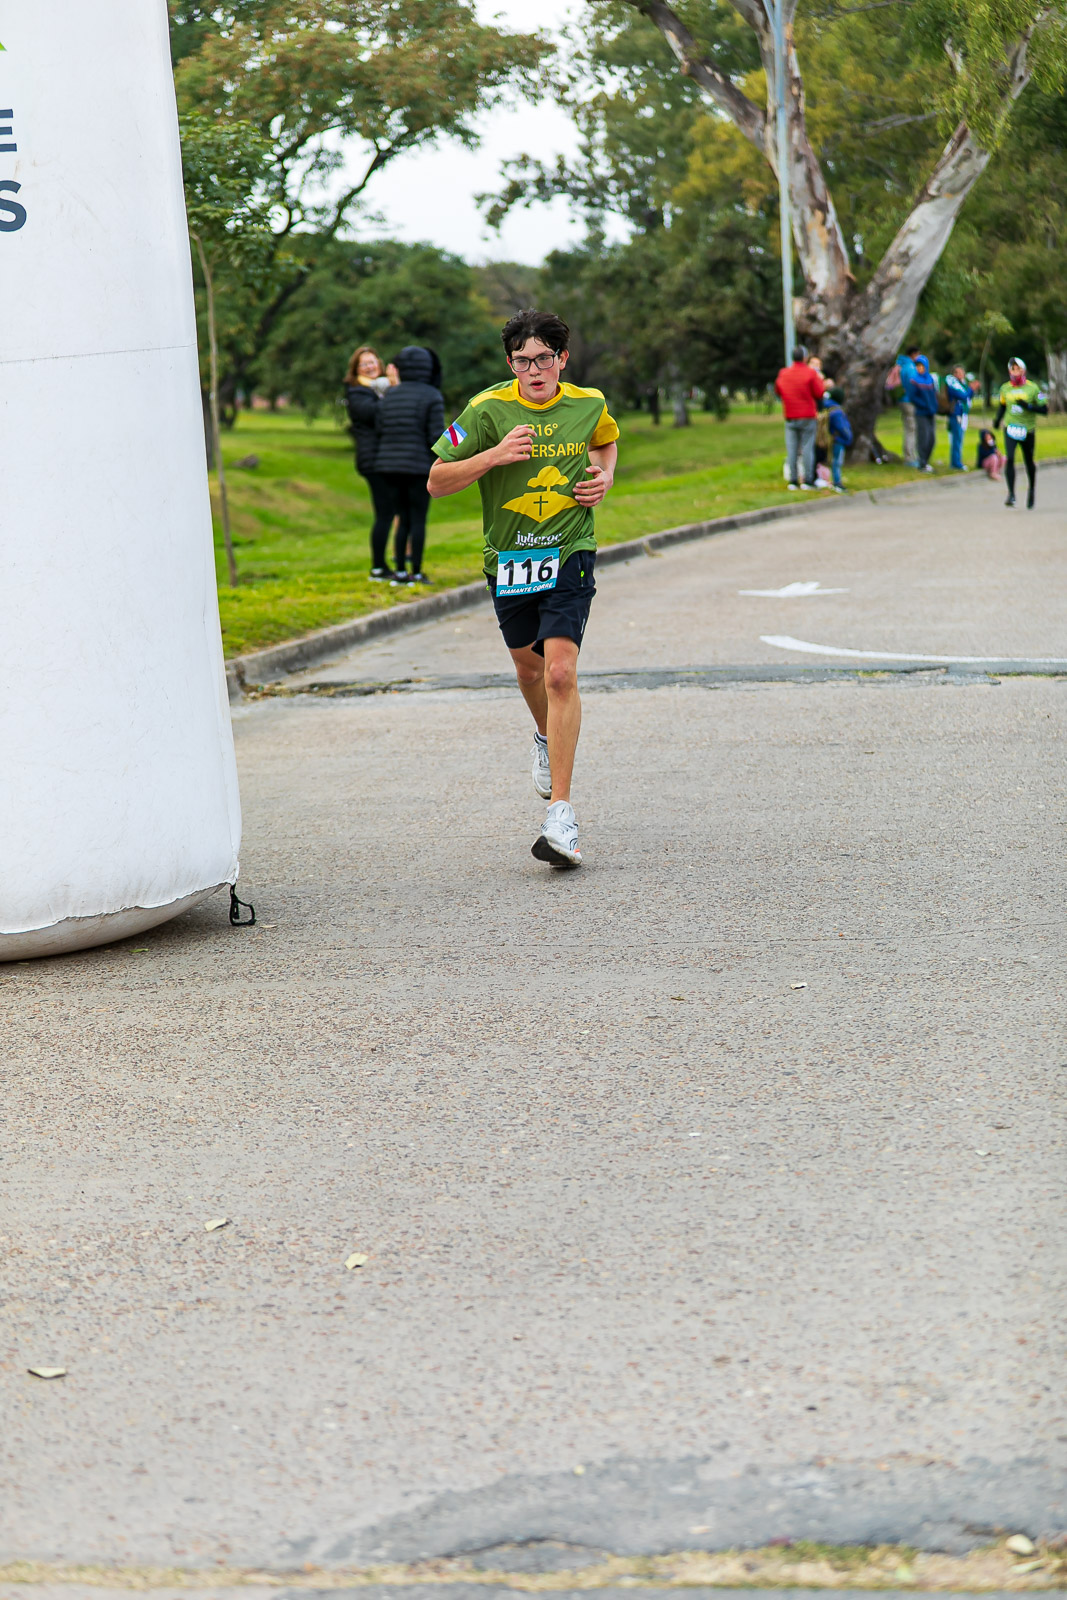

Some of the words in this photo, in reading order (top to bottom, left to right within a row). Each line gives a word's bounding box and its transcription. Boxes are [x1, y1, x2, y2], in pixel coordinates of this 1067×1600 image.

[504, 555, 553, 587] 116
[500, 586, 532, 595] DIAMANTE
[533, 582, 553, 591] CORRE
